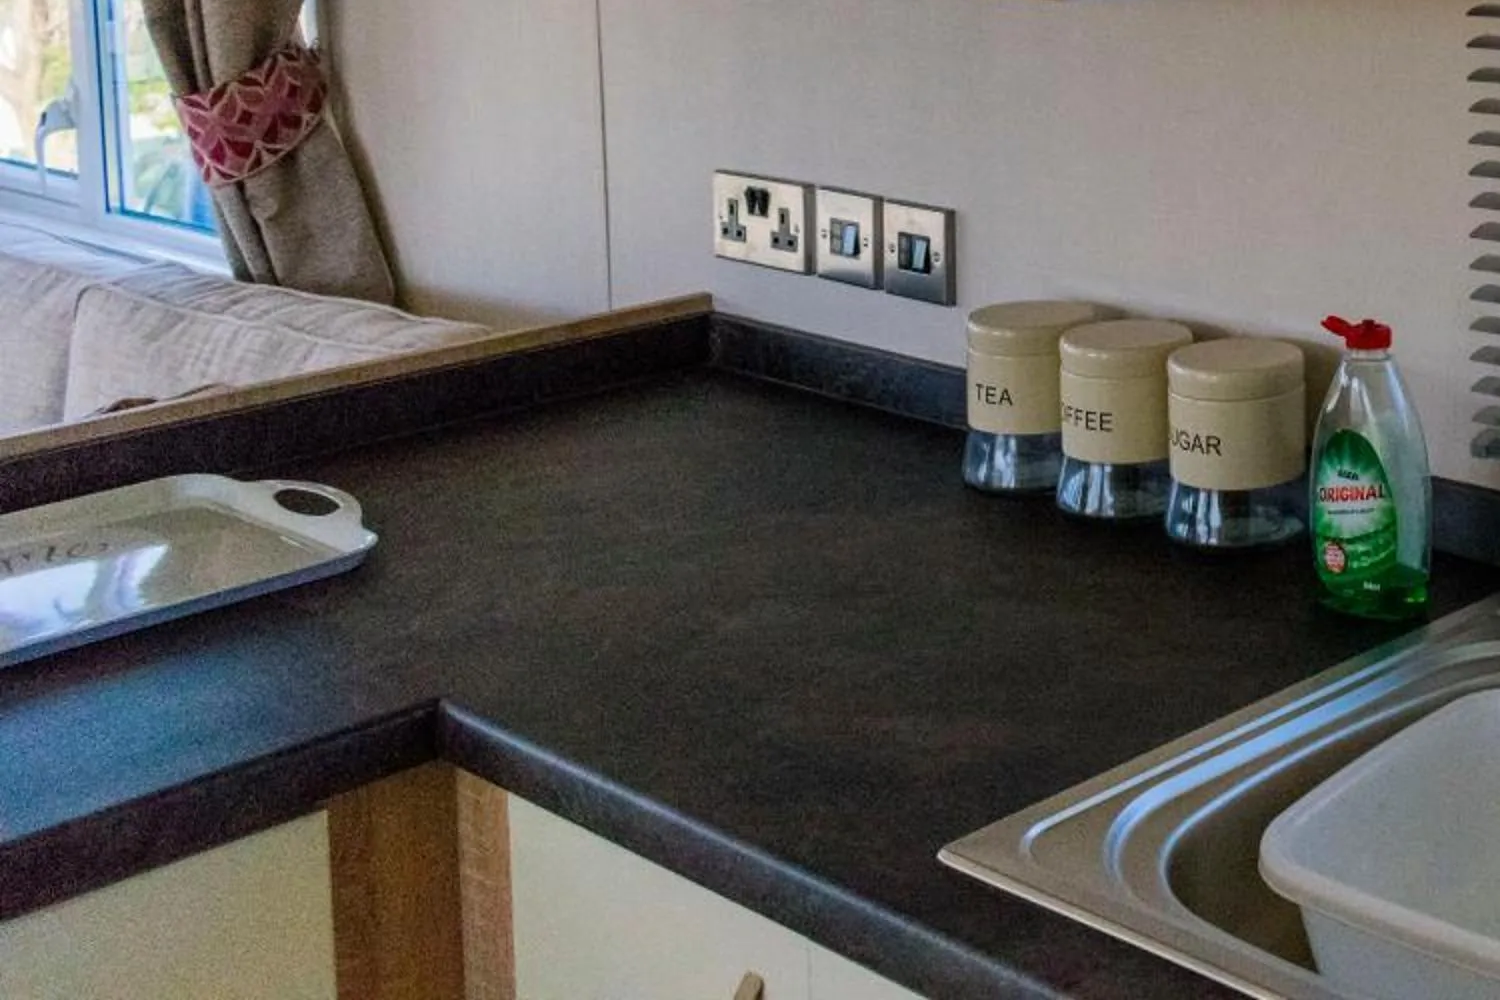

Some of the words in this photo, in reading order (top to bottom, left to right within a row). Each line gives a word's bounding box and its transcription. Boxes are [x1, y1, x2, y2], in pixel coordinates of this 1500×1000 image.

[975, 383, 1013, 406] TEA
[1063, 405, 1113, 432] FFEE
[1170, 428, 1222, 456] UGAR
[1319, 483, 1386, 502] ORIGINAL
